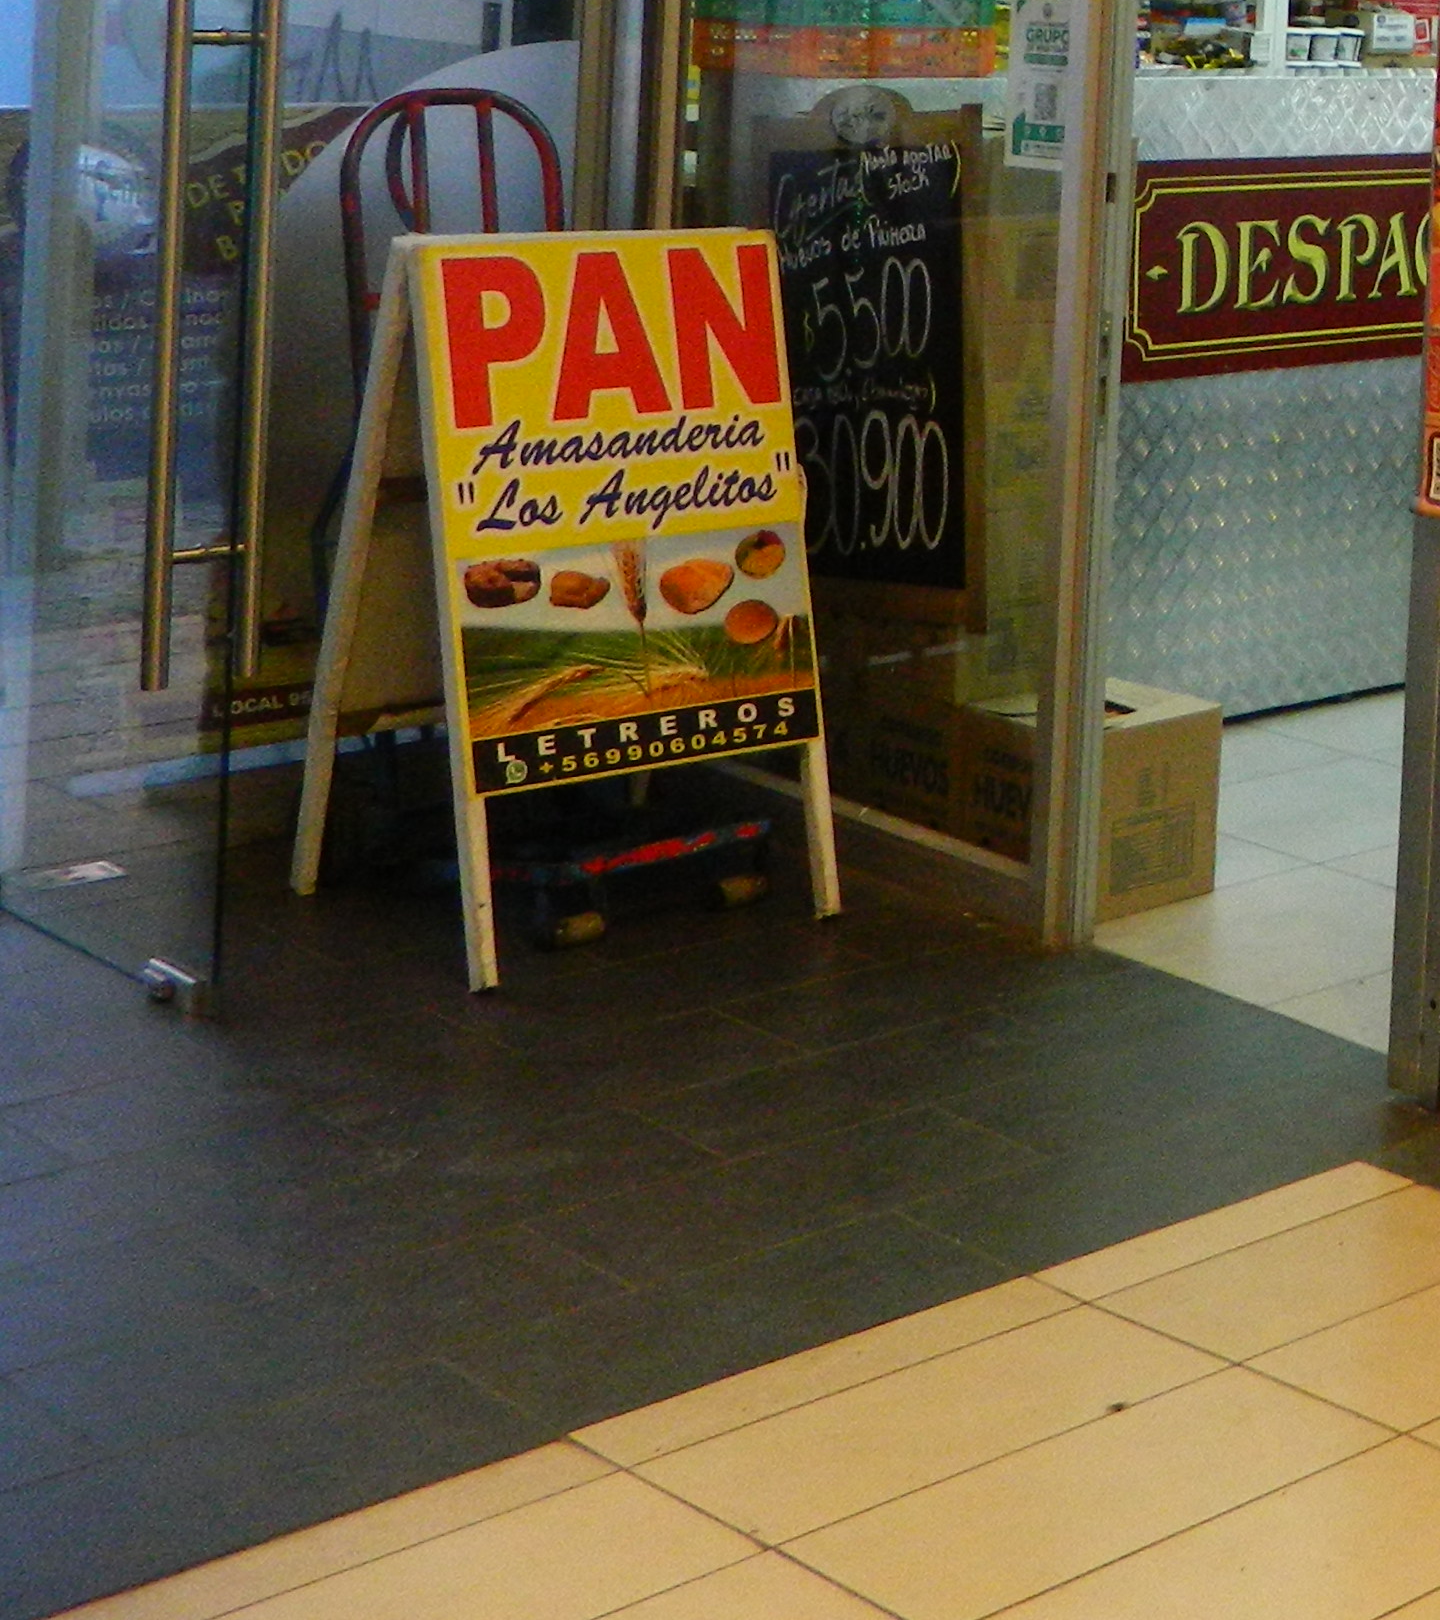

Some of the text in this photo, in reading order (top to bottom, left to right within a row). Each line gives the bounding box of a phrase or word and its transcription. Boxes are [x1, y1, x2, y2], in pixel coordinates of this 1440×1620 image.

[440, 243, 782, 430] PAN
[472, 415, 765, 476] Amasanderia
[497, 695, 796, 764] LETREROS
